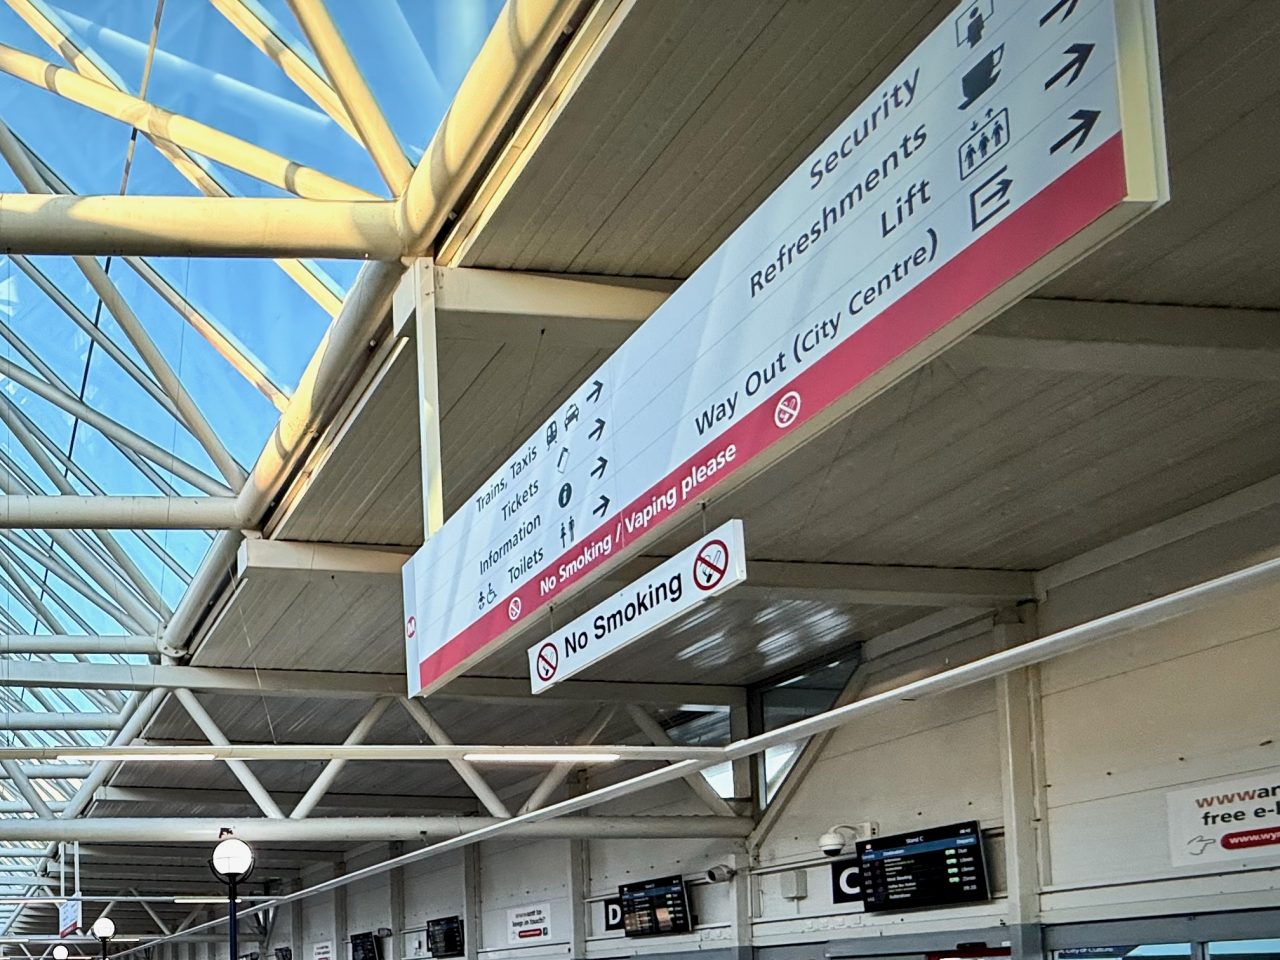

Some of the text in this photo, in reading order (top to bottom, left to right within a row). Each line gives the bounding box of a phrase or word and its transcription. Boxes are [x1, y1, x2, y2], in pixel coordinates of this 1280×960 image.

[810, 67, 920, 190] Security
[750, 124, 927, 298] Refreshments
[881, 179, 931, 238] Lift
[695, 227, 938, 436] Way Out (City Centre)
[476, 445, 537, 513] Trains, Taxis
[501, 479, 539, 522] Tickets
[479, 514, 541, 575] Information
[539, 577, 557, 597] No
[559, 534, 612, 583] Smoking
[624, 486, 677, 533] Vaping
[681, 443, 737, 500] please
[508, 547, 544, 584] Toilets
[564, 573, 683, 658] No Smoking
[1201, 811, 1246, 826] free
[839, 866, 860, 894] C
[608, 904, 622, 925] D
